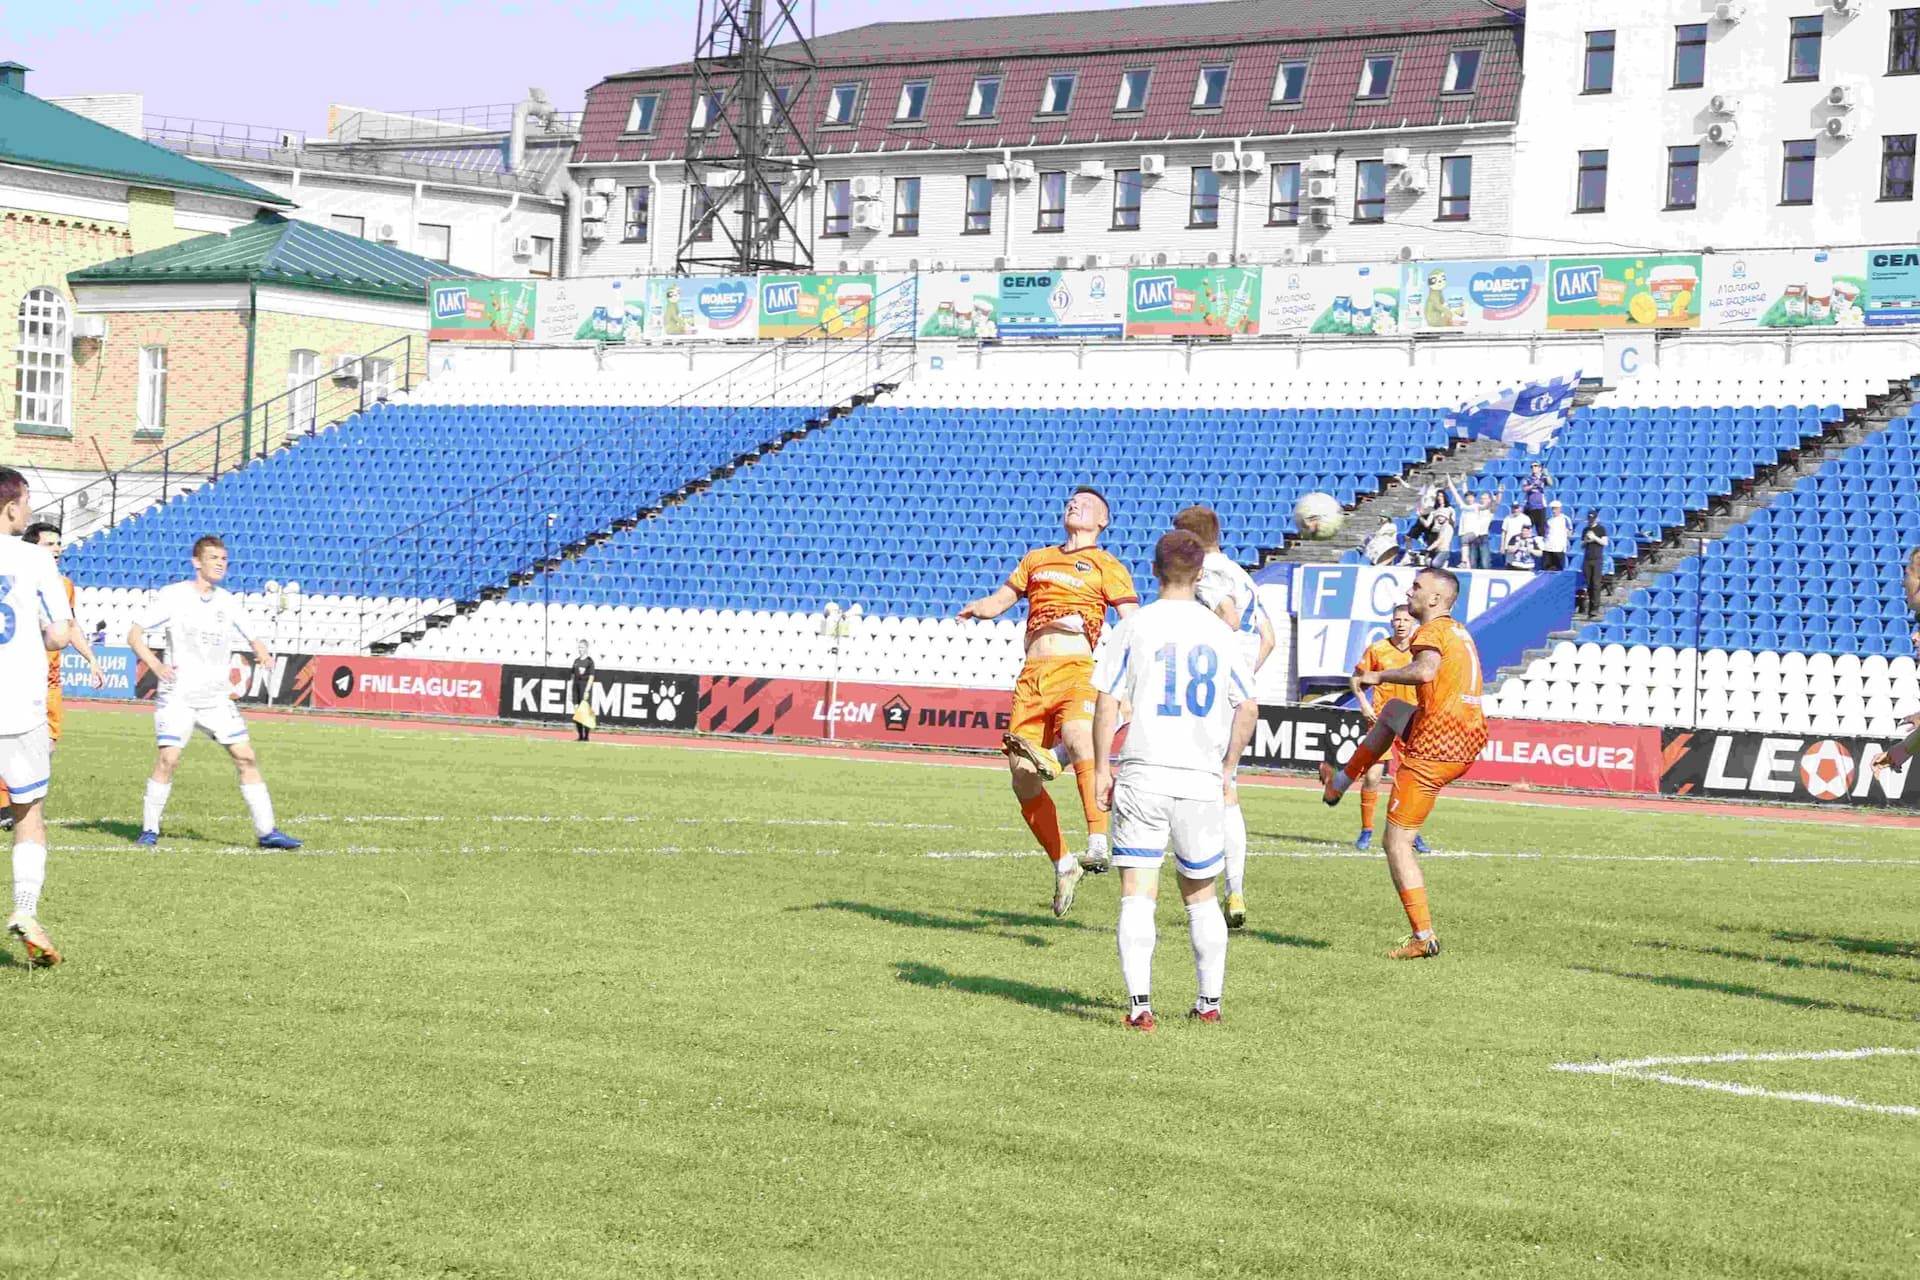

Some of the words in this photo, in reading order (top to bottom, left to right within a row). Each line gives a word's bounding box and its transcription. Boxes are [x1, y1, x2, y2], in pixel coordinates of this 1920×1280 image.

[1003, 276, 1052, 288] СЕЛФ
[1472, 278, 1529, 293] МОДЕСТ
[61, 654, 127, 673] СТРЦИЯ
[60, 672, 129, 689] БАРНУЛА
[359, 674, 482, 699] FNLEAGUE2
[1155, 642, 1218, 718] 18
[512, 677, 650, 719] KELME
[812, 700, 877, 723] LEON
[918, 708, 990, 730] ЛИГА
[1704, 735, 1911, 800] LEON
